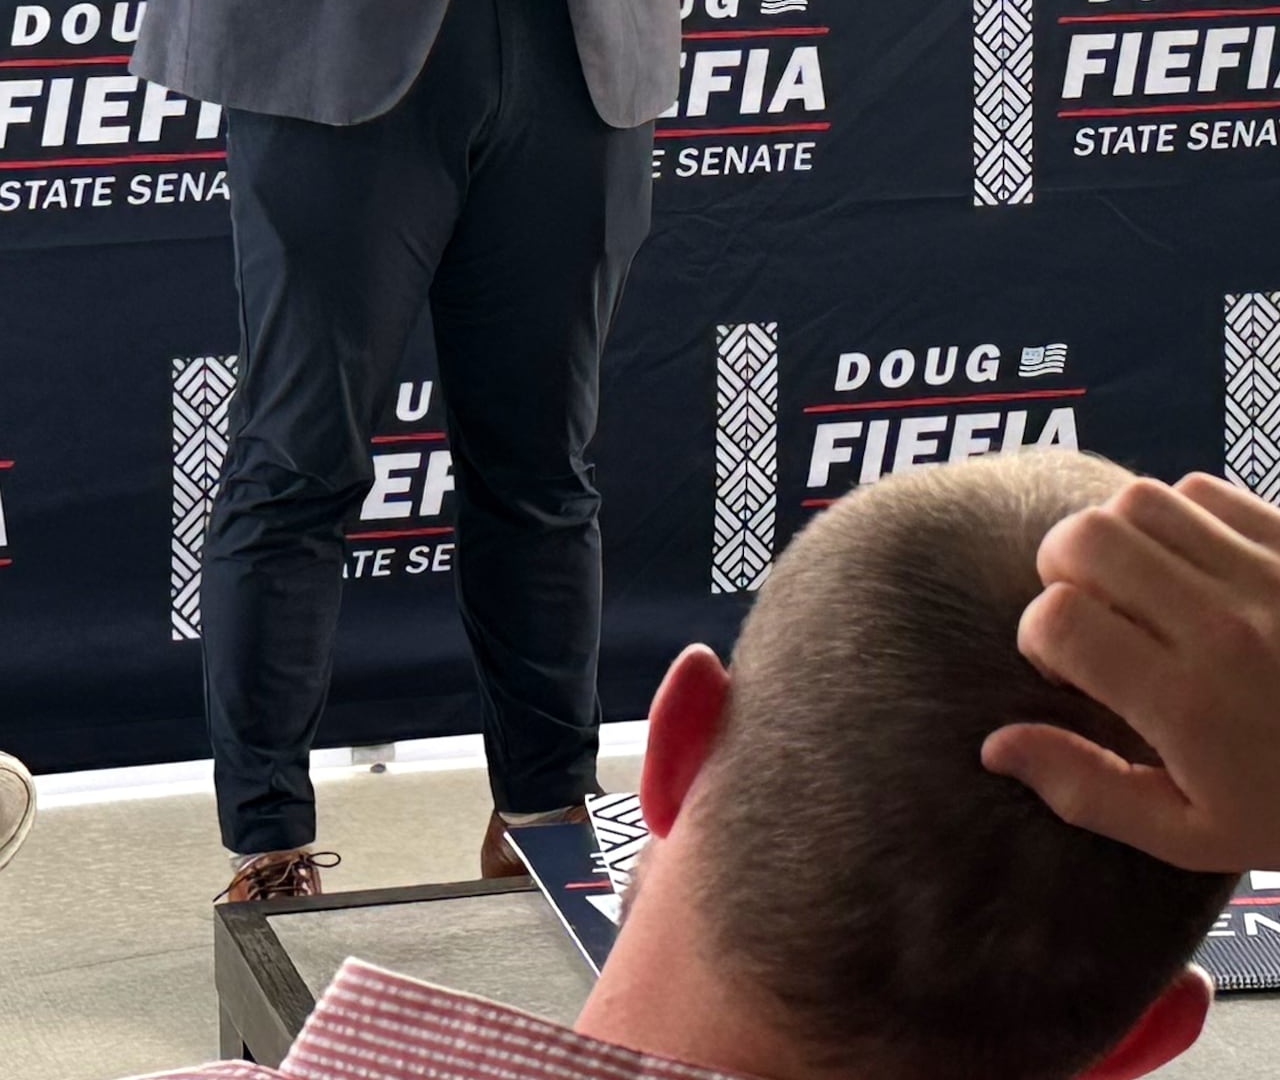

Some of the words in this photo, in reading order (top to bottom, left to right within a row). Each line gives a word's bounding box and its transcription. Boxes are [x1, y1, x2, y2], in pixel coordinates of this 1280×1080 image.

[10, 1, 148, 46] DOU
[660, 46, 826, 118] FIA
[675, 142, 816, 177] SENATE
[1073, 124, 1178, 156] STATE
[126, 171, 231, 204] SENA
[834, 343, 1001, 392] DOUG
